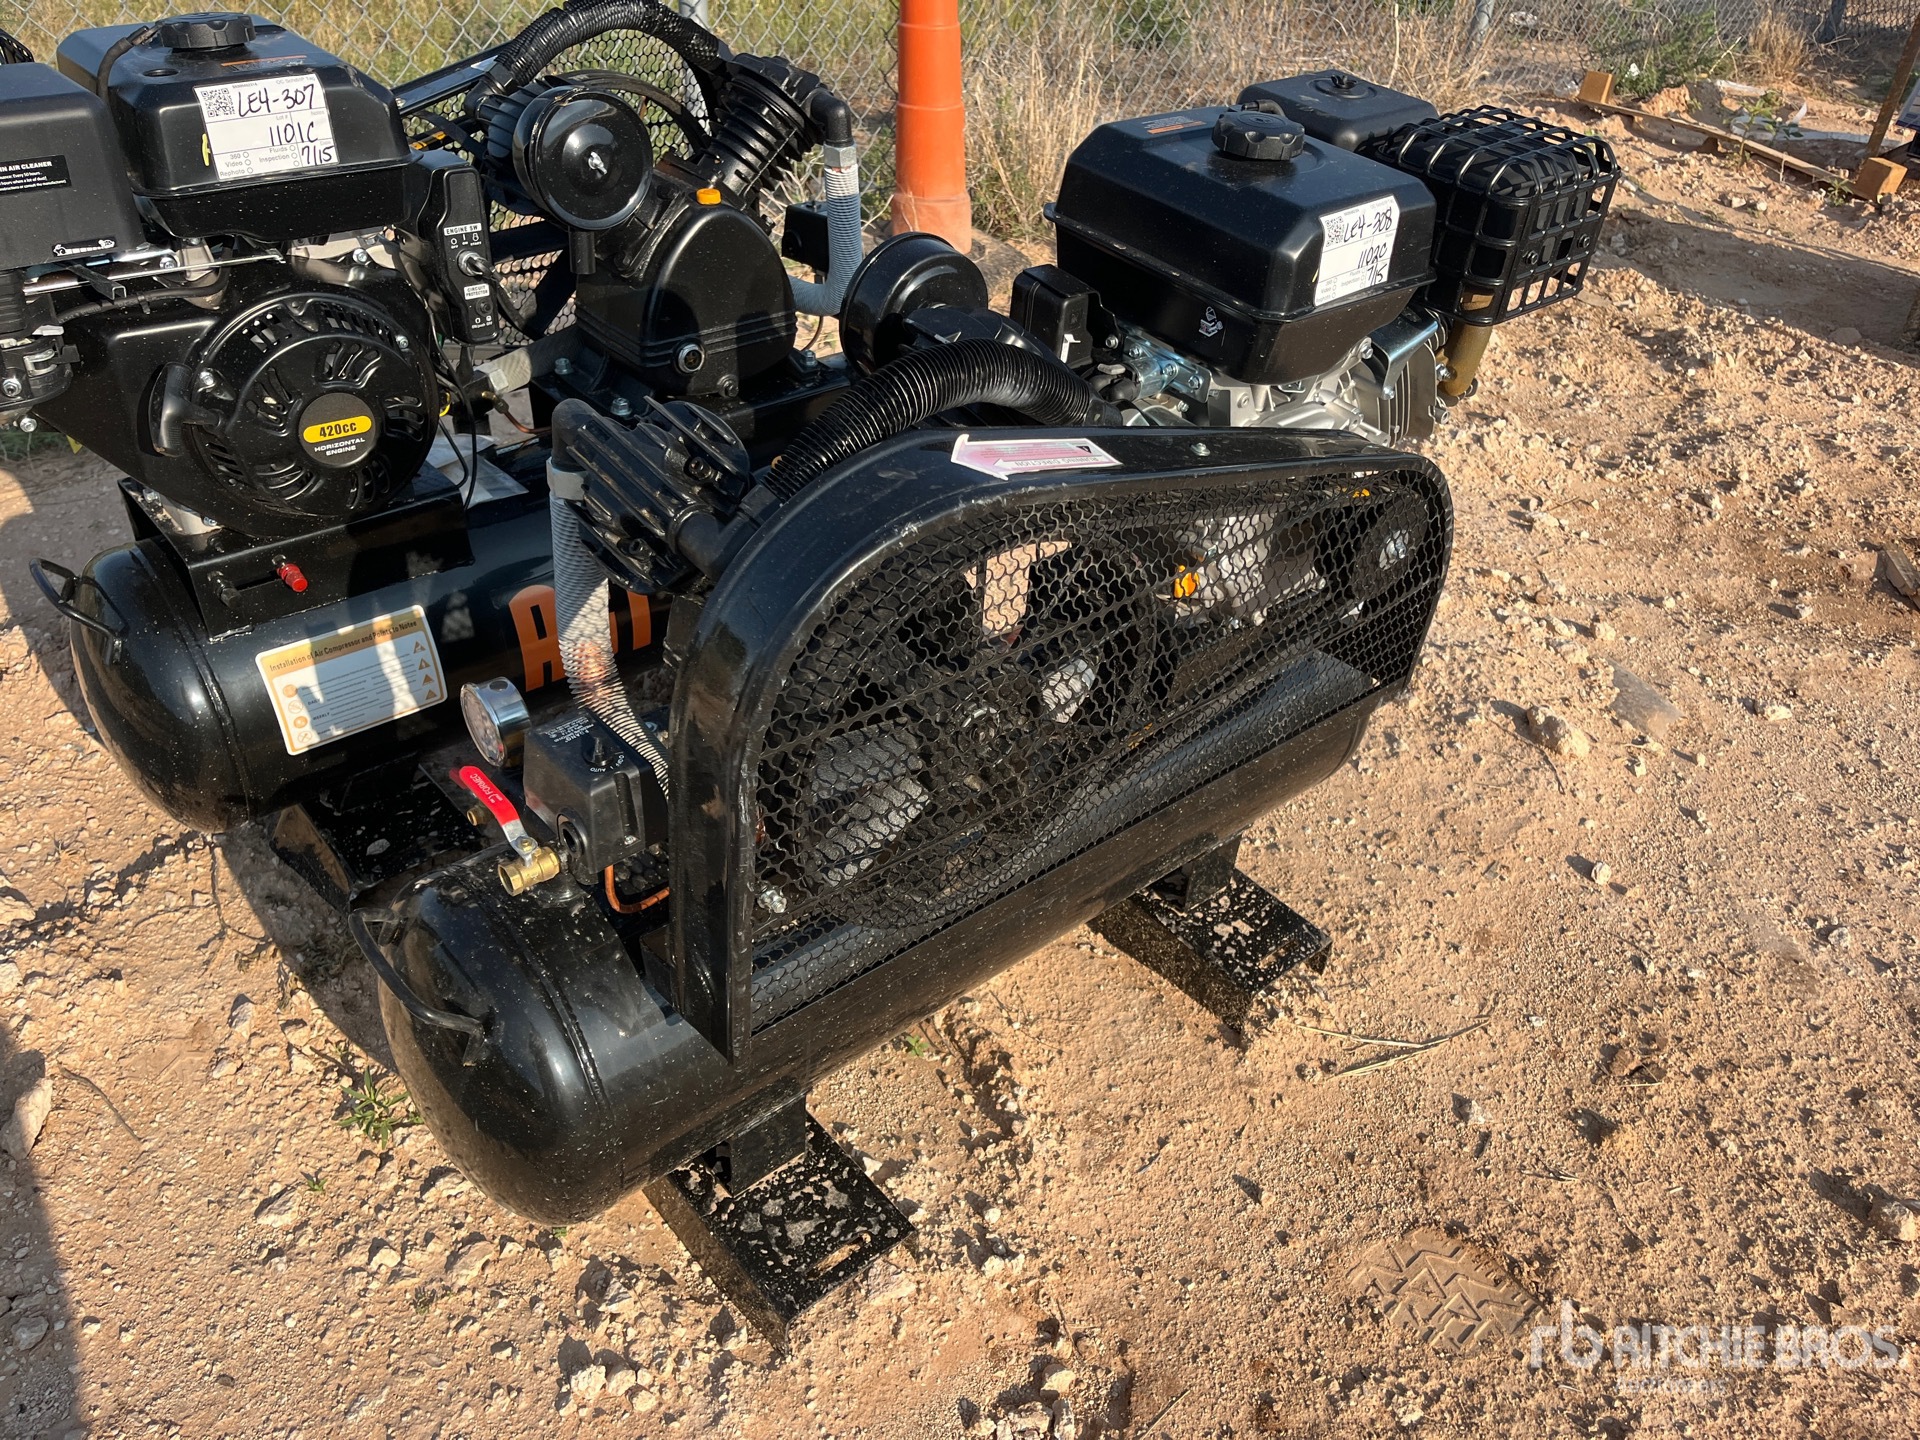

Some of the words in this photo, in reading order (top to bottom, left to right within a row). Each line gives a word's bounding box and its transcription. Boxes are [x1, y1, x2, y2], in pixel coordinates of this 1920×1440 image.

[238, 83, 314, 118] LE4-307
[269, 121, 318, 146] 1101C
[259, 154, 290, 164] Inspection
[301, 145, 334, 166] 7/15
[21, 161, 52, 170] CLEANER
[220, 169, 245, 177] Rephoto
[320, 422, 357, 438] 420cc
[314, 437, 366, 452] HORIZONTAL
[326, 445, 356, 456] ENGINE
[1061, 456, 1098, 465] RUNNING
[270, 656, 306, 672] Installation
[307, 652, 314, 660] of
[314, 650, 323, 658] Air
[324, 638, 360, 654] Compressor
[361, 634, 372, 643] and
[372, 630, 392, 640] Points
[313, 712, 330, 720] WEEKLY
